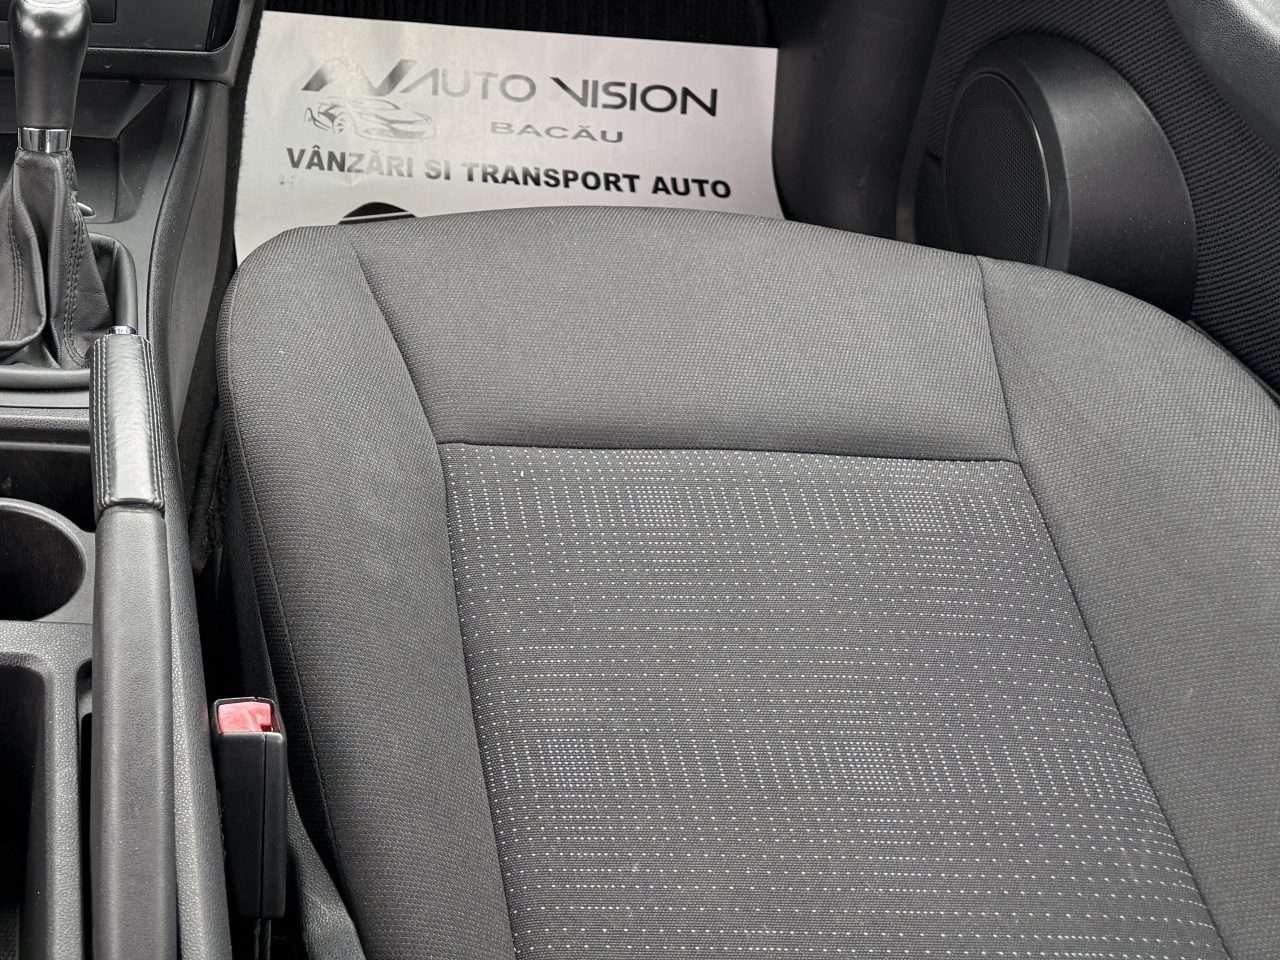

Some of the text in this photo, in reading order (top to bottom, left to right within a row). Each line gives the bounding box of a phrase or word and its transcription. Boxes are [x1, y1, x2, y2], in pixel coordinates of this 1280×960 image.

[401, 68, 536, 102] AUTO
[551, 77, 718, 116] VISION
[491, 121, 624, 143] BACĂU
[287, 144, 732, 198] VÂNZĂRI SI TRANSPORT AUTO
